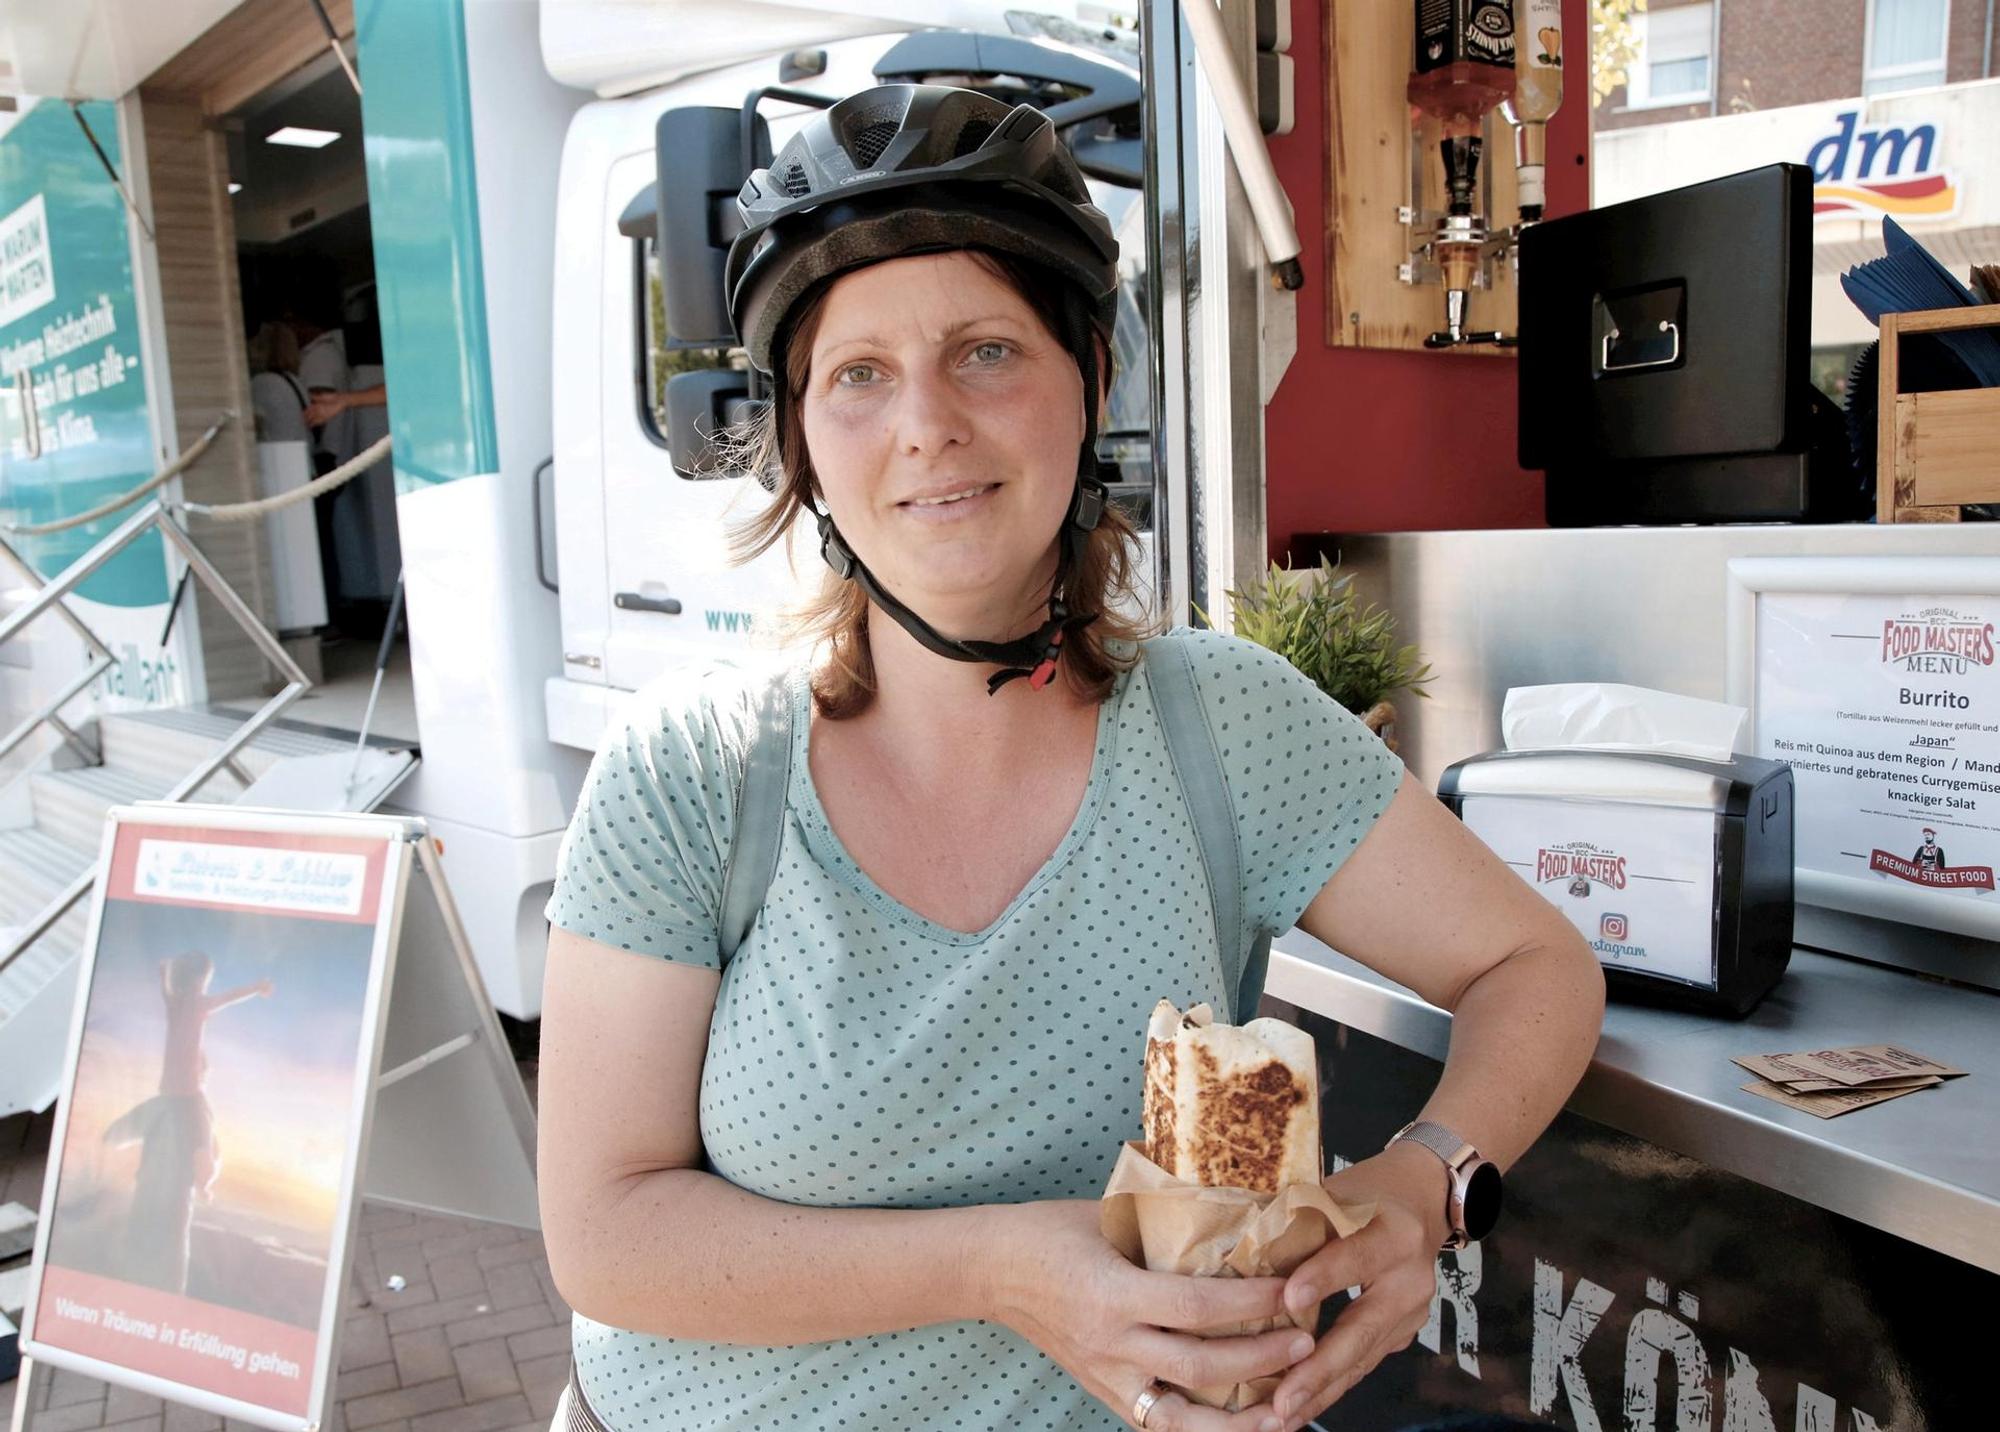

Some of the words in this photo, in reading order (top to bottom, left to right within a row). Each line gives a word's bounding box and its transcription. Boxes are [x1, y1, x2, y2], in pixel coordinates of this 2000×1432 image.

[1806, 112, 1936, 184] dm
[1920, 607, 1959, 619] ORIGINAL
[1882, 619, 1921, 662] FOOD
[1924, 623, 1994, 665] MASTERS
[1906, 655, 1968, 675] MENÜ
[1899, 687, 1970, 709] Burrito
[1883, 715, 1929, 727] Weizenmehl
[1930, 719, 1953, 728] lecker
[1954, 722, 1981, 731] gefüllt
[1982, 724, 1999, 732] und
[1774, 739, 1794, 751] Reis
[1796, 742, 1814, 753] mit
[1816, 744, 1854, 758] Quinoa
[1856, 750, 1875, 760] aus
[1878, 750, 1903, 763] dem
[1905, 754, 1945, 768] Region
[1951, 757, 1959, 771] /
[1833, 766, 1854, 776] und
[1855, 767, 1919, 784] gebratenes
[1921, 774, 2000, 793] Currygemüse
[1887, 788, 1943, 807] knackiger
[1945, 796, 1976, 810] Salat
[1567, 842, 1599, 853] ORIGINAL
[1537, 848, 1568, 883] FOOD
[1571, 856, 1626, 890] MASTERS
[1876, 854, 1919, 879] PREMIUM
[1921, 870, 1958, 883] STREET
[1960, 871, 1987, 882] FOOD
[55, 1297, 100, 1324] Wenn
[103, 1307, 156, 1339] Träume
[160, 1322, 177, 1344] in
[178, 1327, 249, 1369] Erfüllung
[248, 1351, 300, 1379] gehen
